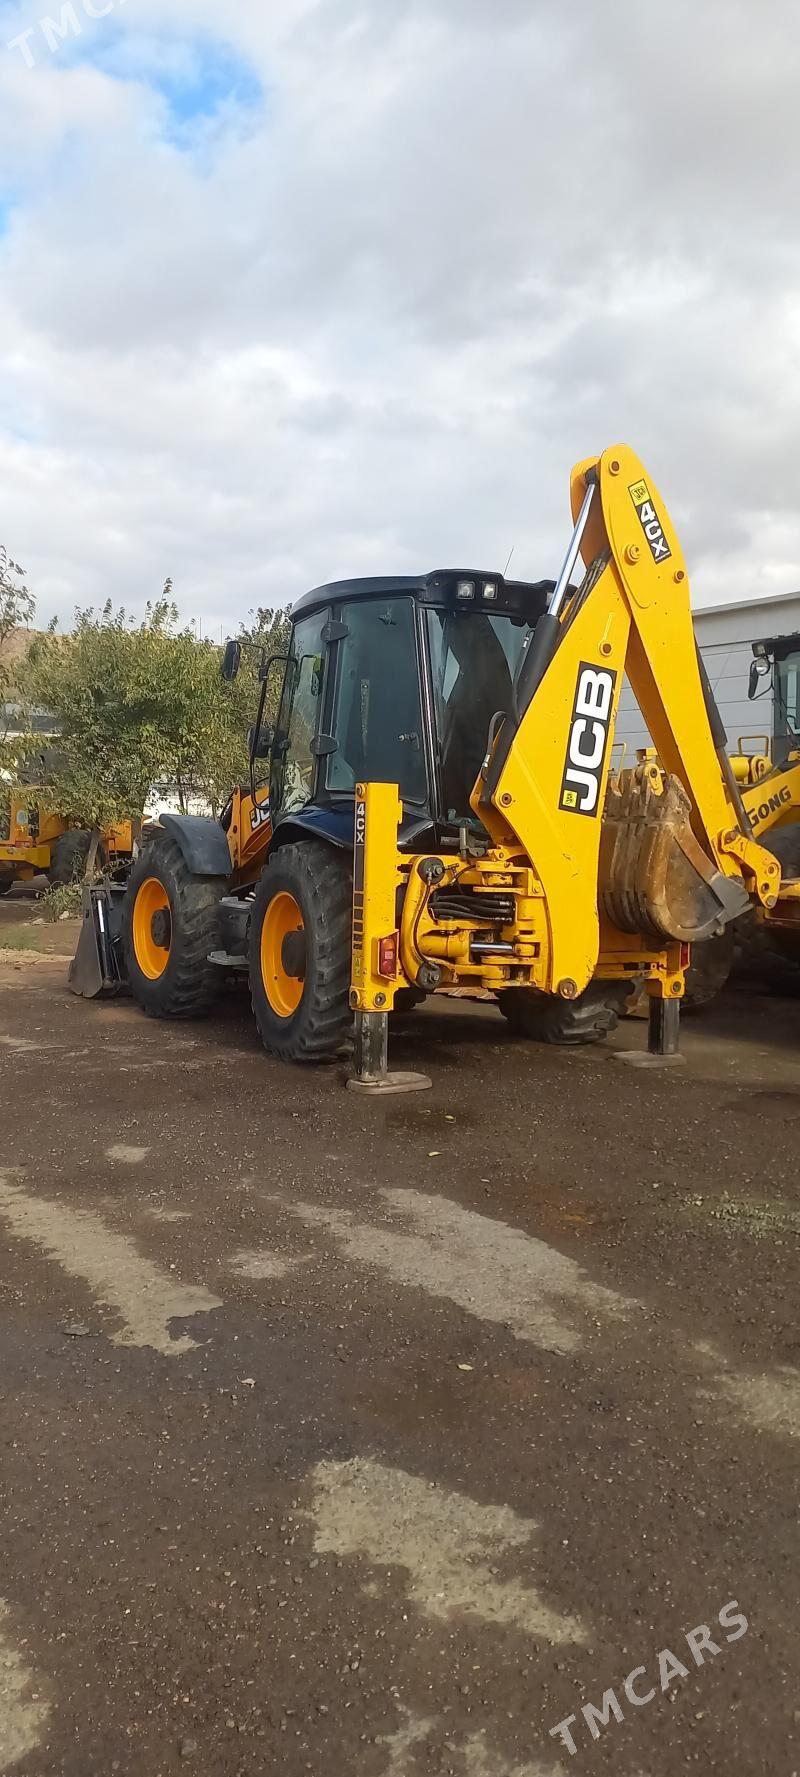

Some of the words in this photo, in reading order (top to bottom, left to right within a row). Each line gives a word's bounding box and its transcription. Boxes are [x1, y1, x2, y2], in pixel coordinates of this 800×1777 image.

[640, 501, 669, 557] 4CX
[565, 669, 613, 811] JCB
[251, 797, 270, 829] JC
[356, 803, 365, 843] 4CX
[744, 785, 792, 828] GONG
